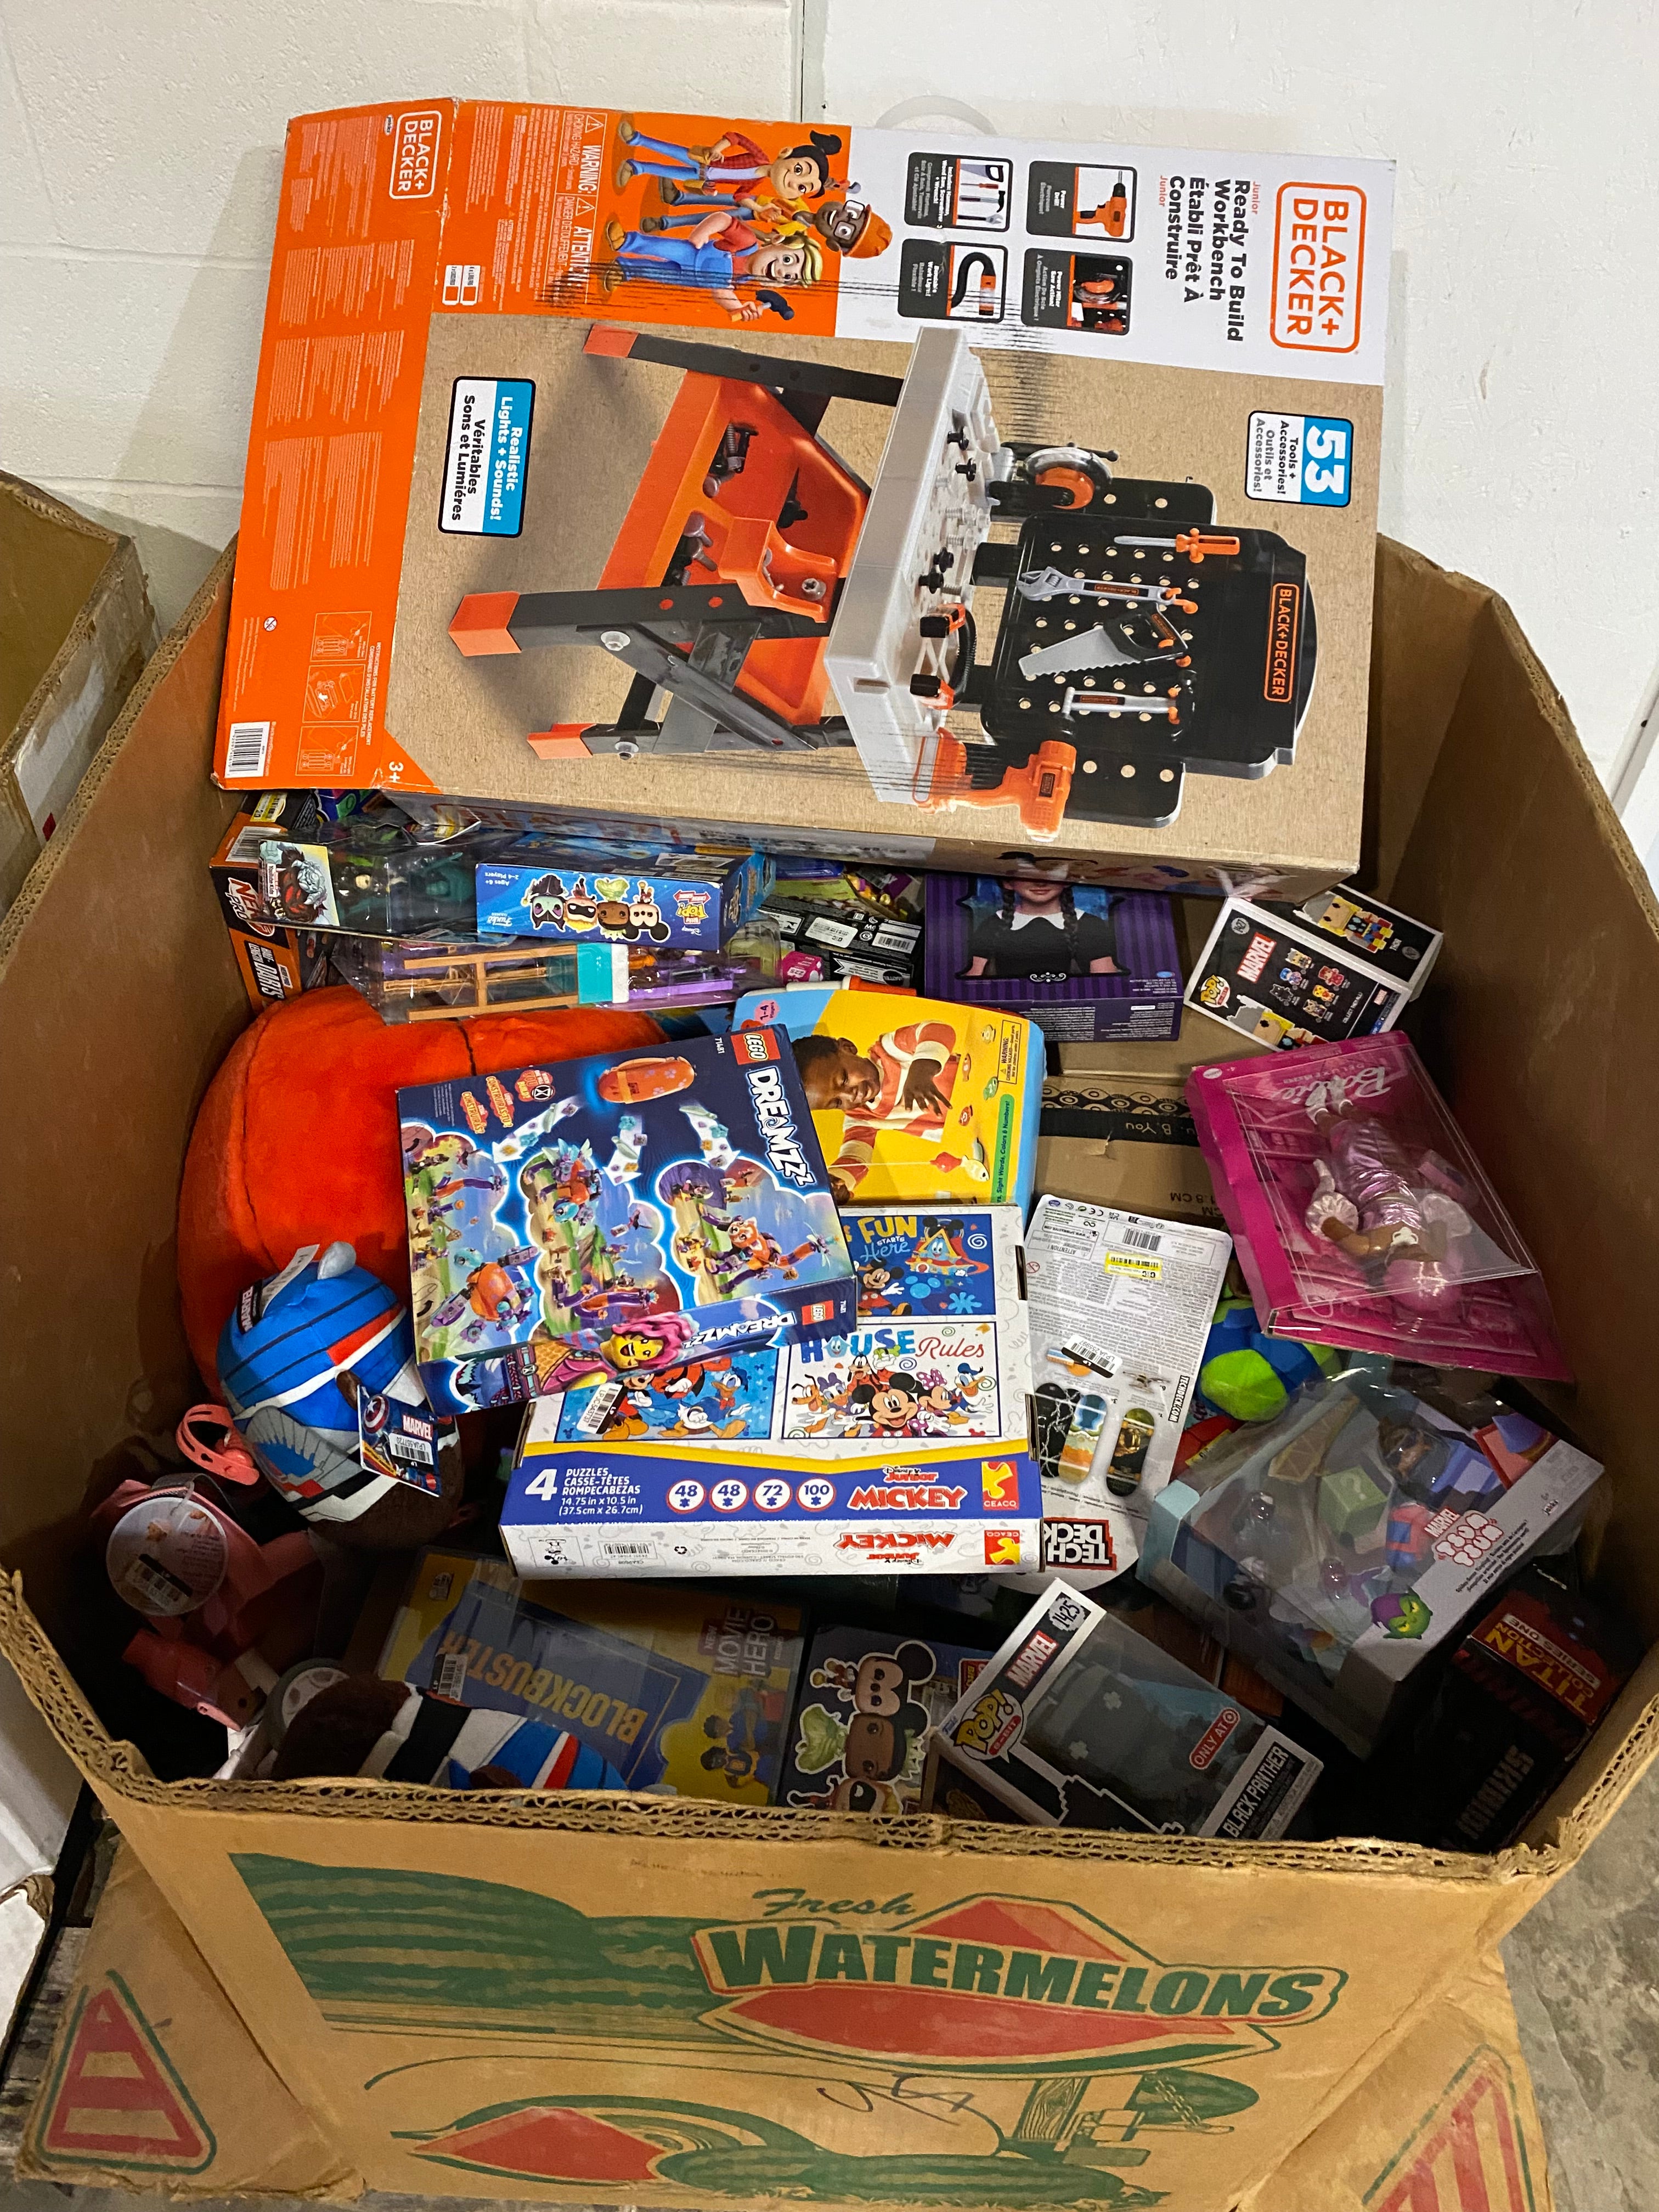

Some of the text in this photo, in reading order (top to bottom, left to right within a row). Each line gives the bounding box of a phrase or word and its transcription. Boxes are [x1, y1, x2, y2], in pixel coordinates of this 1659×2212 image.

[398, 121, 418, 191] DECKER
[415, 120, 433, 190] BLACK+
[578, 145, 601, 193] WARNING:
[1158, 175, 1167, 207] Junior
[1251, 182, 1261, 215] Junior
[1165, 176, 1185, 279] Construire
[1184, 177, 1209, 302] Établi Prêt À
[1209, 179, 1231, 301] Workbench
[1227, 180, 1250, 341] Ready To Build
[1287, 198, 1318, 334] DECKER
[1318, 200, 1349, 335] BLACK+
[462, 395, 475, 431] Sons
[460, 435, 470, 449] et
[467, 420, 486, 494] Véritables
[490, 397, 513, 520] Lights + Sounds!
[1264, 430, 1275, 480] Outils et
[1278, 420, 1289, 494] Accessories!
[1289, 438, 1299, 469] Tools
[505, 427, 522, 492] Realistic
[1305, 425, 1346, 494] 53
[1271, 589, 1292, 696] BLACK+DECKER
[388, 761, 404, 783] 3+
[228, 878, 264, 923] NER
[487, 916, 512, 927] Funko
[1237, 935, 1276, 982] MARVEL
[254, 961, 285, 998] DARTS
[1200, 974, 1224, 1005] POP!
[742, 1032, 767, 1061] LEGO
[1272, 1066, 1392, 1099] Baie
[1125, 1122, 1156, 1135] You
[1170, 1193, 1192, 1203] CM
[857, 1216, 917, 1244] FUN
[877, 1236, 905, 1246] STARTS
[860, 1240, 911, 1262] Here
[1050, 1244, 1077, 1256] ATTENTION
[241, 1284, 255, 1334] MARVEL
[811, 1304, 824, 1321] LEGO
[915, 1337, 985, 1360] Rules
[1169, 1376, 1189, 1422] TECHDECK.COM
[403, 1415, 433, 1441] MARVEL
[524, 1469, 558, 1500] 4
[564, 1474, 630, 1485] CASSE-TÊTES
[566, 1468, 609, 1477] PUZZLES
[561, 1497, 585, 1505] 14.75
[606, 1496, 625, 1504] 10.5
[627, 1496, 636, 1504] in
[562, 1485, 641, 1496] ROMPECABEZAS
[674, 1485, 698, 1497] 48
[717, 1485, 740, 1497] 48
[763, 1485, 782, 1497] 72
[805, 1485, 830, 1496] 100
[848, 1486, 968, 1510] MICKEY
[558, 1505, 595, 1516] (37.5cm
[605, 1505, 643, 1515] 26.7cm)
[1424, 1508, 1461, 1538] MARVEL
[833, 1533, 957, 1549] MICKEY
[1043, 1522, 1103, 1544] DECK
[1452, 1525, 1505, 1568] TSUM
[1048, 1543, 1110, 1564] TECH
[1053, 1602, 1081, 1629] 1425
[706, 1624, 715, 1650] NEW
[714, 1606, 749, 1676] MOVIE
[741, 1612, 776, 1677] HERO
[1508, 1616, 1601, 1689] SERIES ONE
[1006, 1633, 1056, 1688] MARVEL
[1485, 1628, 1589, 1717] TITAN
[1496, 1622, 1595, 1699] COLLECTION
[440, 1630, 648, 1745] BLOCKBUSTER
[954, 1689, 1015, 1753] POP!
[1193, 1721, 1228, 1767] ONLY AT
[1221, 1790, 1258, 1838] BLACK
[1248, 1745, 1290, 1804] PANTHER
[751, 1887, 918, 1920] Fresh
[707, 1923, 1325, 2018] WATERMELONS
